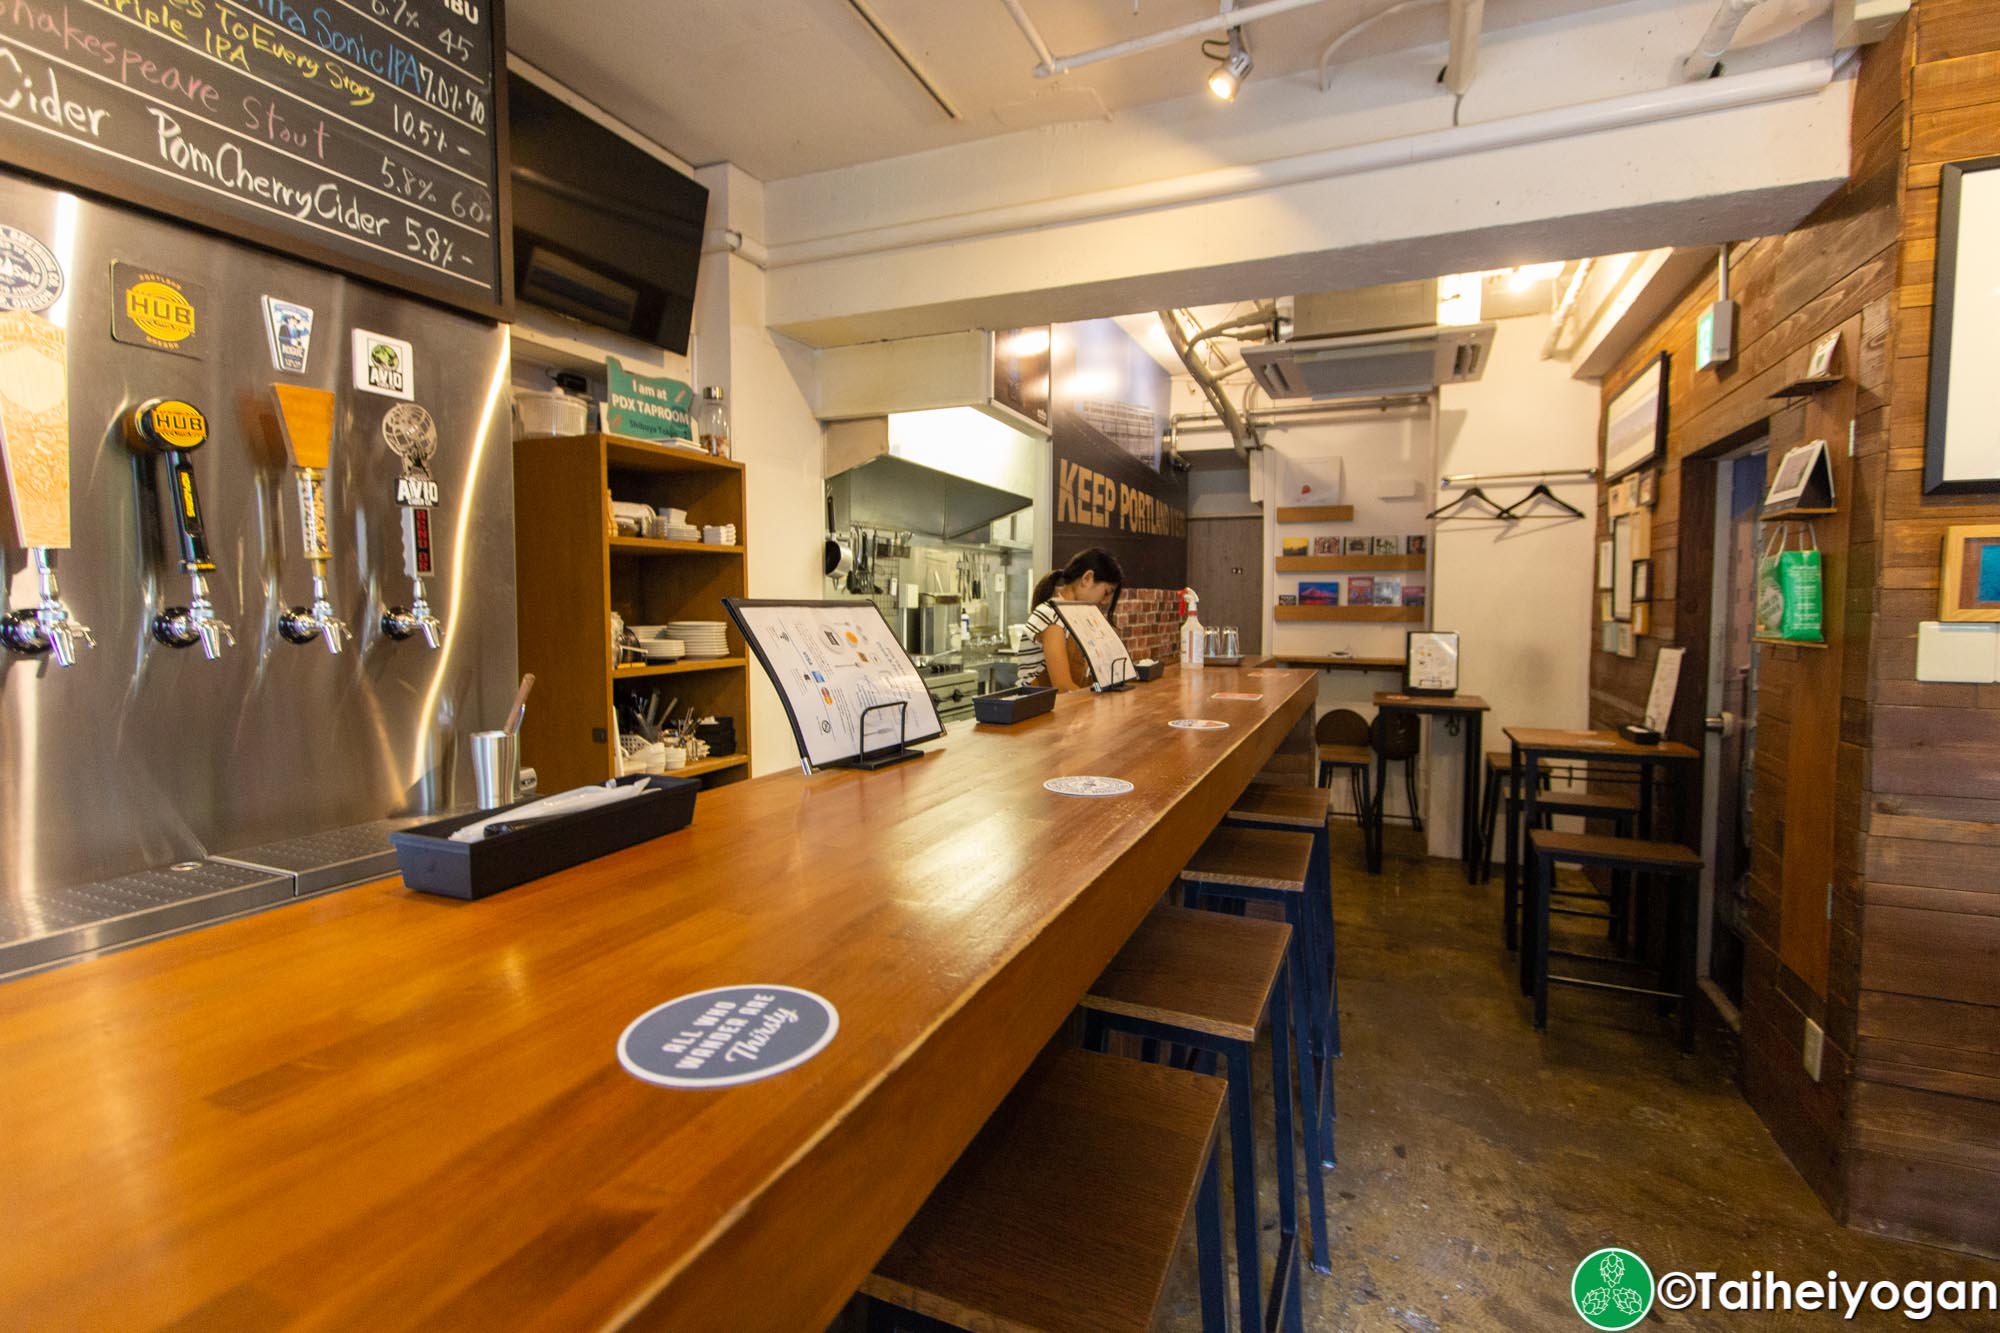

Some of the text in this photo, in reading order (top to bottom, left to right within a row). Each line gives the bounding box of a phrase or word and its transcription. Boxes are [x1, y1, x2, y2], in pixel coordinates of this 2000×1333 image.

[103, 0, 251, 71] riple IPA
[438, 28, 475, 62] 45
[0, 0, 220, 112] hakespeare
[242, 95, 330, 160] Stout
[381, 156, 437, 203] 5.8%
[466, 88, 486, 125] 70
[405, 215, 453, 267] 5.8%
[131, 294, 191, 325] HUB
[612, 393, 689, 425] PDX TAPROOM
[632, 380, 668, 401] I am at
[156, 413, 203, 431] HUB
[397, 478, 439, 503] AVID
[1057, 458, 1116, 528] KEEP
[1120, 482, 1169, 536] PORTLAND
[661, 1000, 737, 1054] ALL WHO
[675, 993, 776, 1071] WANDER ARE
[724, 1006, 799, 1063] Thirsty
